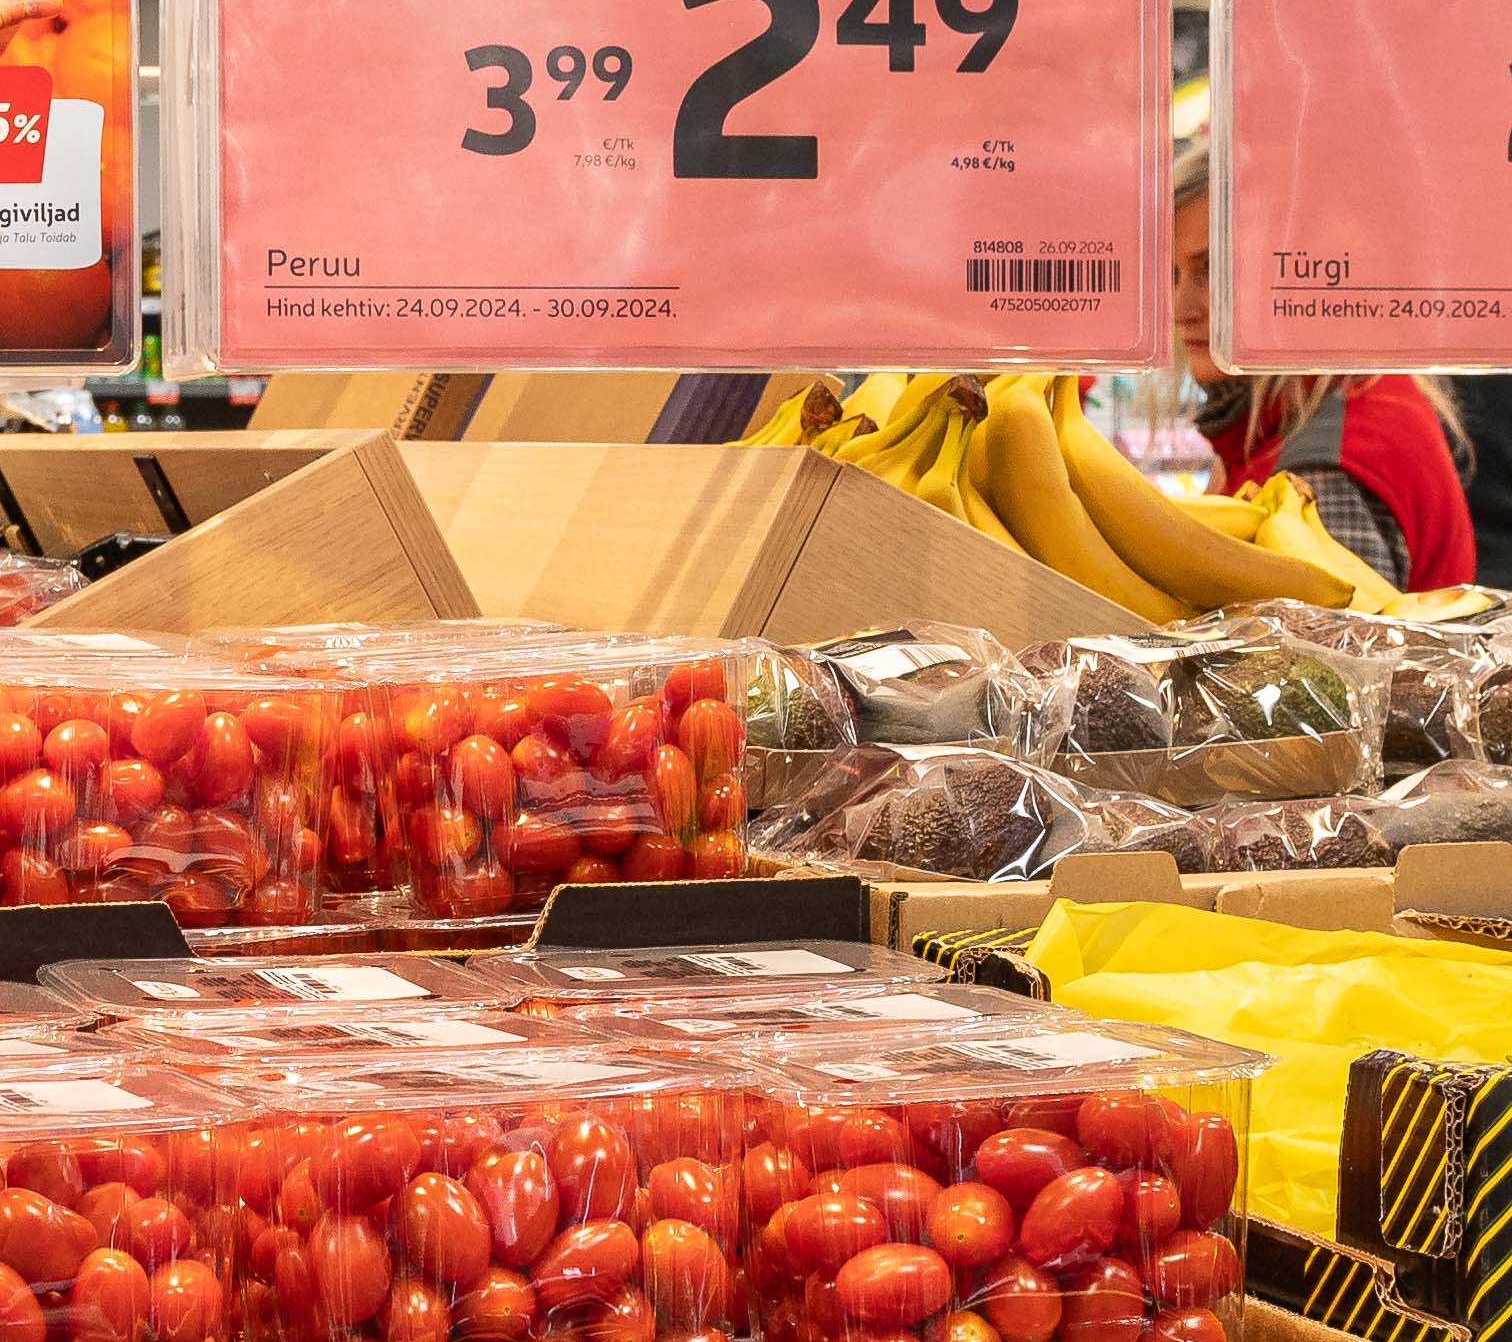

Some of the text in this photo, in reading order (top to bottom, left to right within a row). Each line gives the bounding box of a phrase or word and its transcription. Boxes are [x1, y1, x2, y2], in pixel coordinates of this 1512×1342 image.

[268, 249, 360, 277] Peruu
[1273, 250, 1350, 287] Türgi
[396, 298, 527, 318] 24.09.2024.
[547, 298, 677, 318] 30.09.2024.
[1388, 298, 1506, 319] 24.09.2024.
